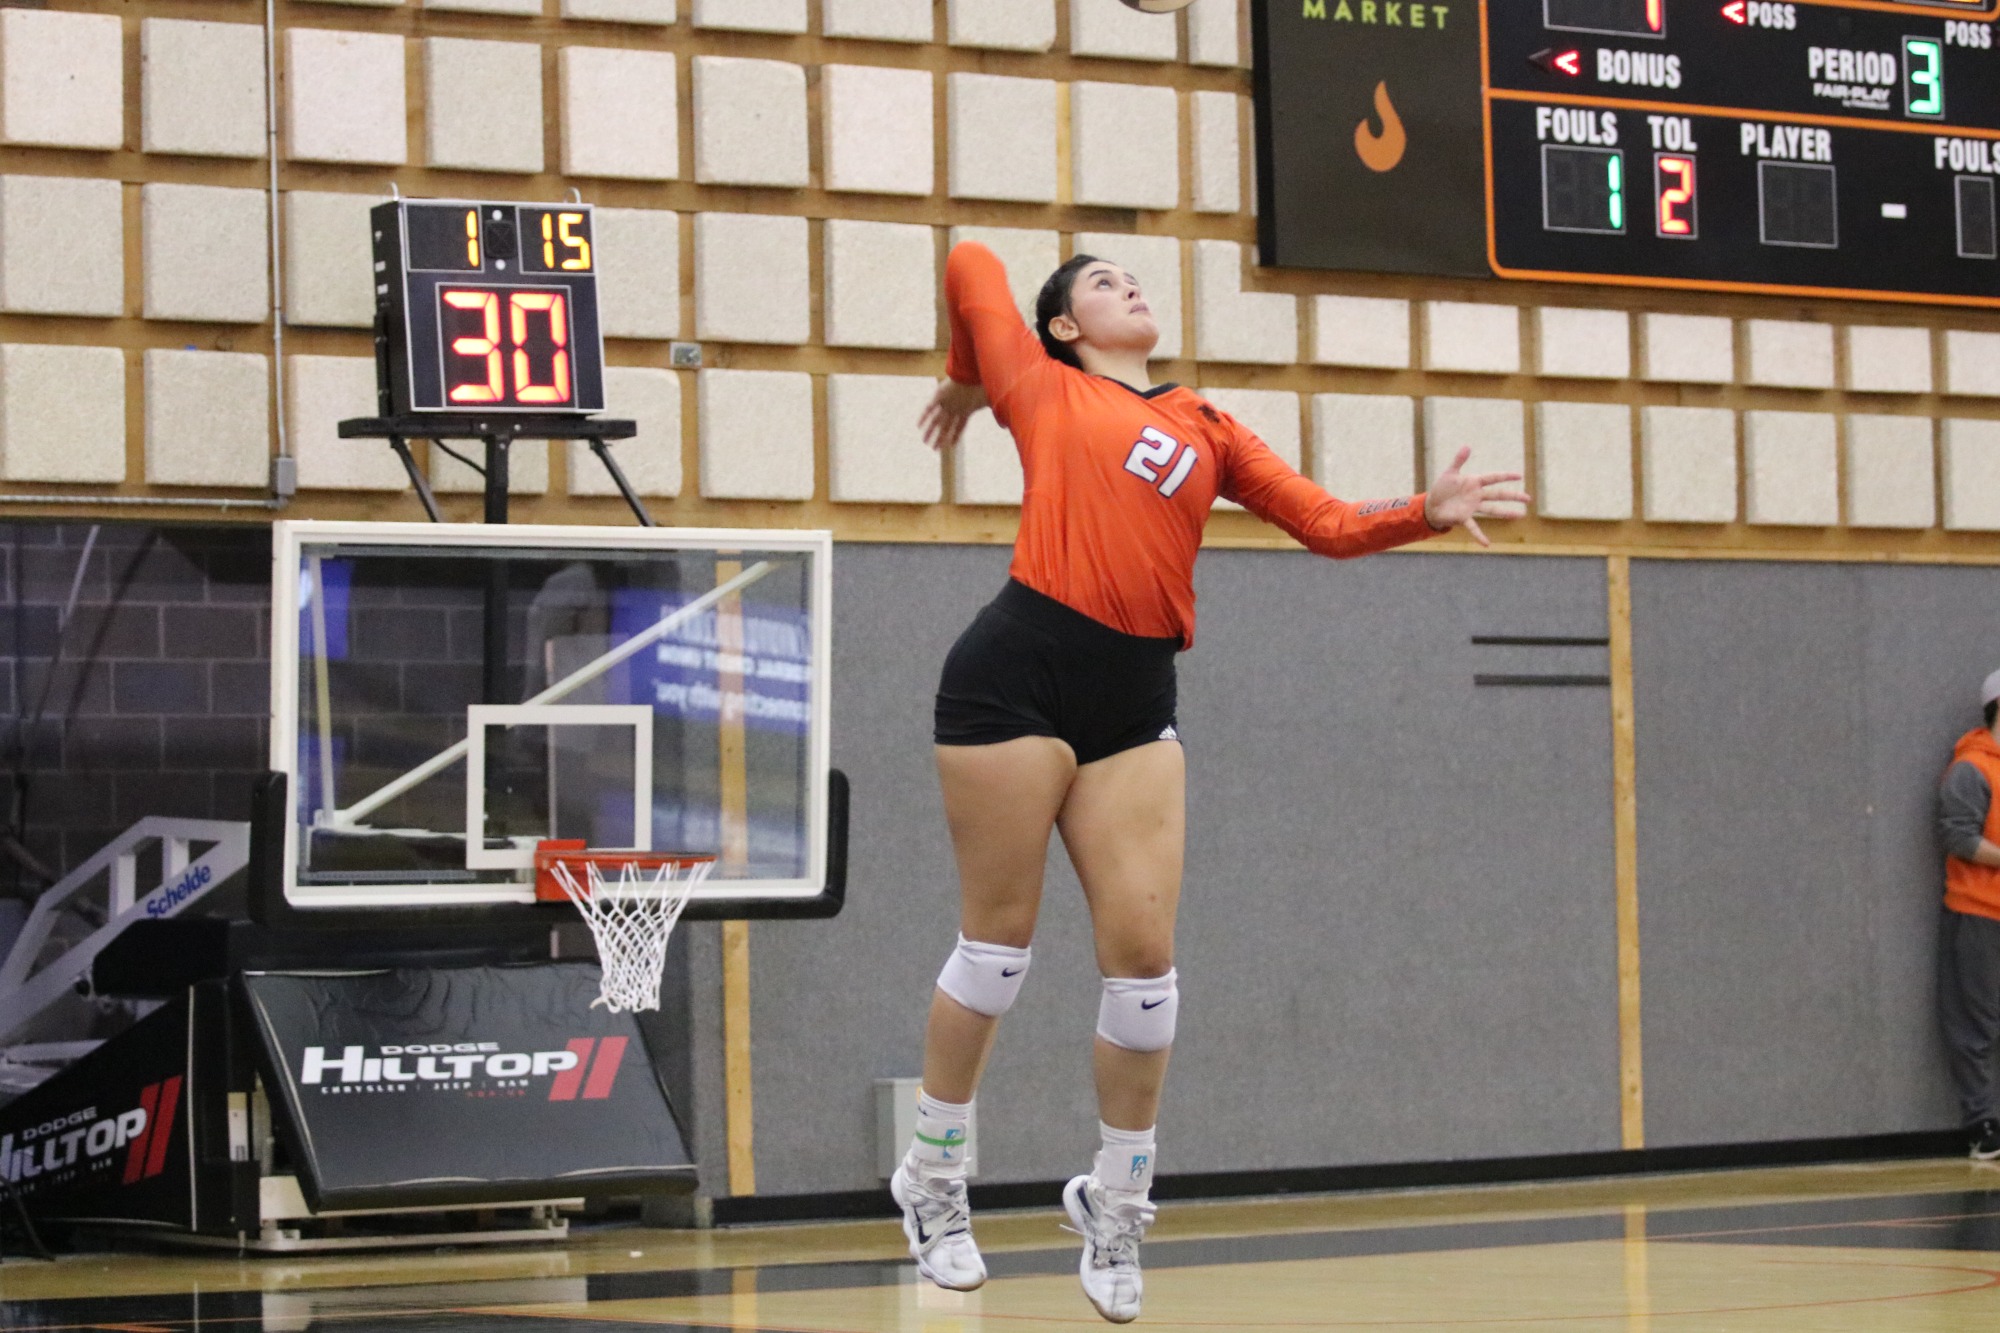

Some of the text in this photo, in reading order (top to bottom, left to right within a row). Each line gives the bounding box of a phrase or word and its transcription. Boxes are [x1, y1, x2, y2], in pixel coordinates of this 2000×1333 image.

[1303, 0, 1449, 30] MARKET
[1747, 2, 1796, 30] POSS
[1945, 20, 1992, 49] POSS
[1597, 48, 1681, 88] BONUS
[1807, 47, 1896, 85] PERIOD
[1906, 41, 1941, 114] 3
[1536, 106, 1618, 146] FOULS
[1647, 115, 1698, 151] TOL
[1740, 123, 1832, 162] PLAYER
[1607, 155, 1622, 229] 1
[1658, 158, 1695, 234] 2
[466, 210, 479, 267] 1
[541, 213, 591, 270] 15
[443, 291, 570, 402] 30
[1123, 425, 1198, 499] 21
[146, 864, 211, 919] Schelde
[380, 1042, 500, 1055] DODGE
[22, 1105, 98, 1142] DODGE
